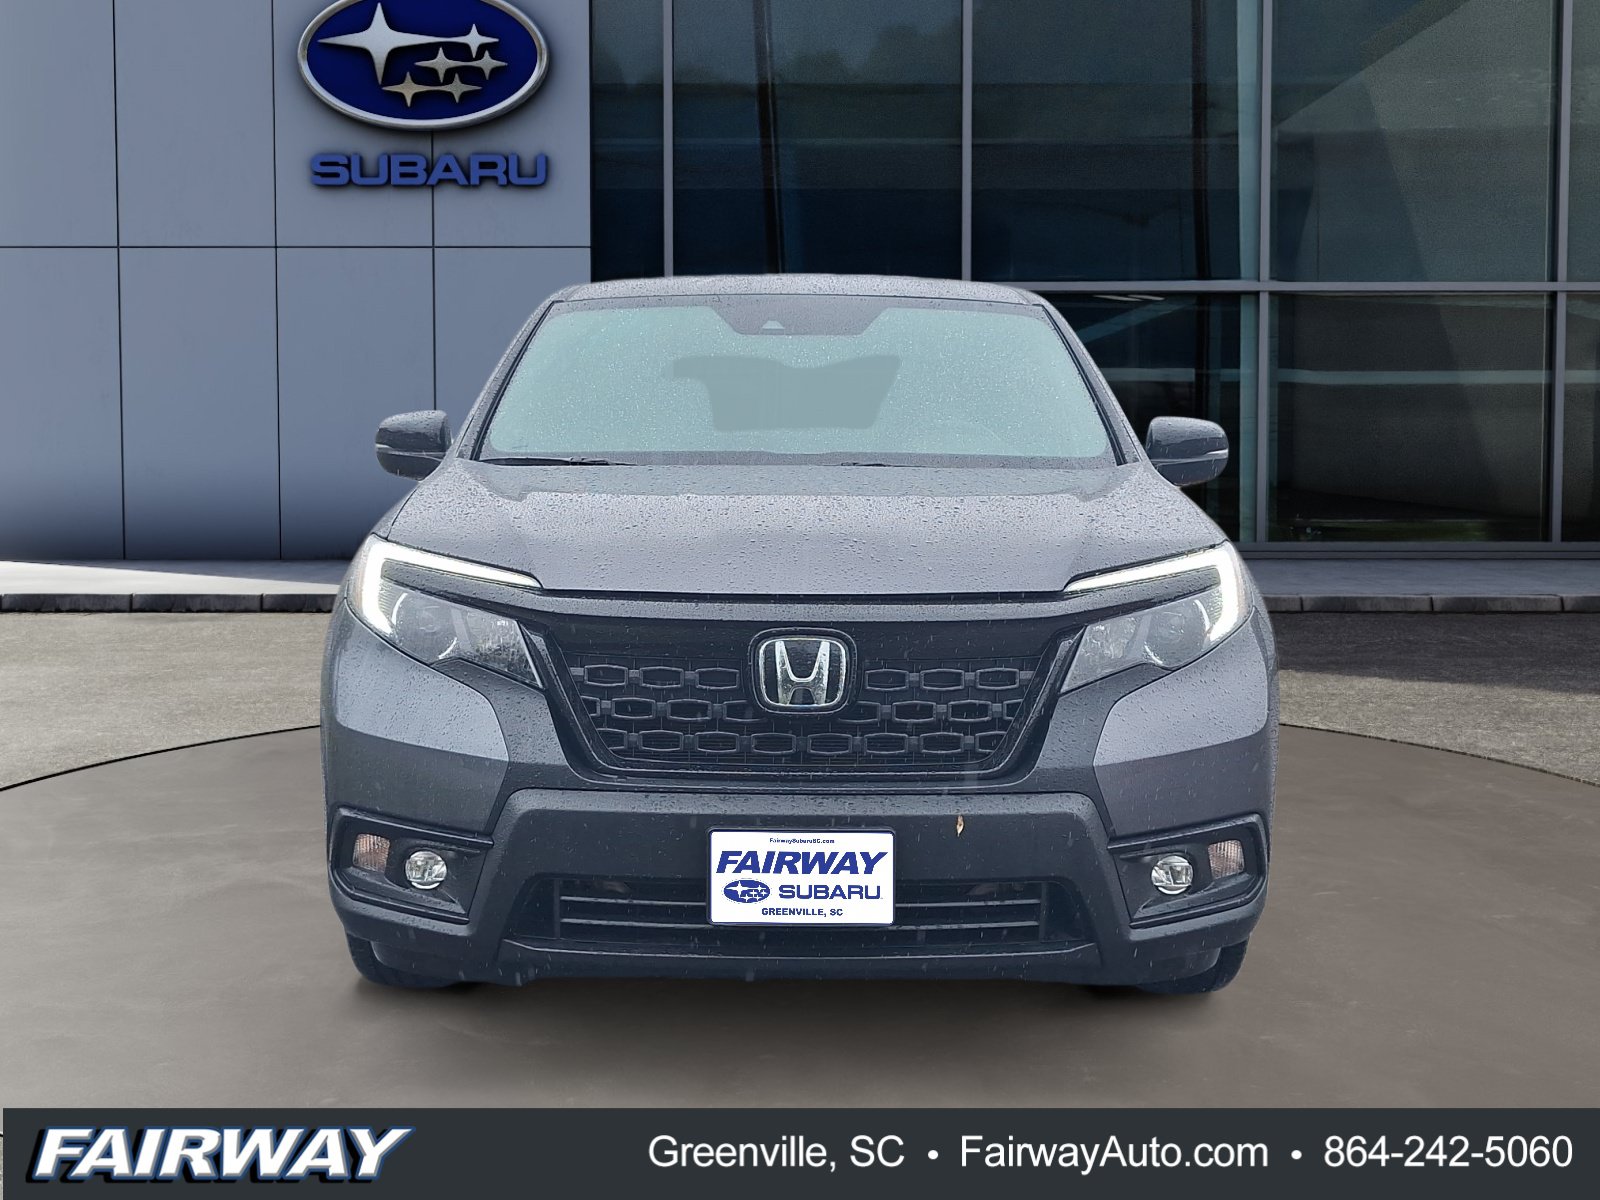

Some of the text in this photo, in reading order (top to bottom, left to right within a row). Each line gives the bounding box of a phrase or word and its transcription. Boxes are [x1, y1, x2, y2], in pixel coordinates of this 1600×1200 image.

[311, 153, 548, 186] SUBARU
[716, 851, 888, 875] FAIRWAY
[778, 884, 881, 900] SUBARU
[761, 907, 844, 918] GREENVILLE, SC
